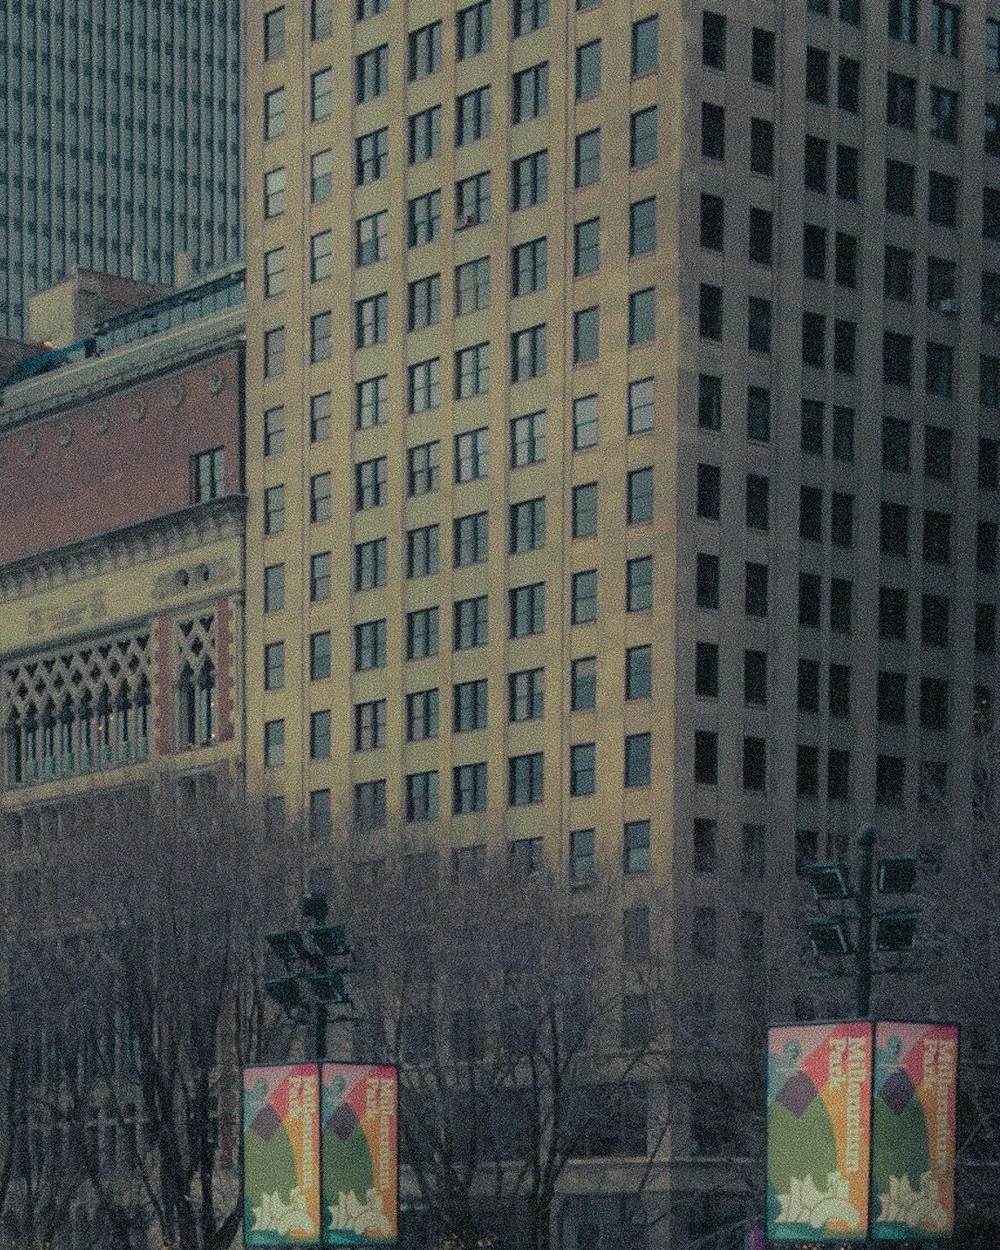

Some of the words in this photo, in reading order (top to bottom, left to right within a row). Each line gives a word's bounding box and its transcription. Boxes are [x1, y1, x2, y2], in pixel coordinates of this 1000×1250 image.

[829, 1037, 845, 1089] Park
[923, 1039, 937, 1089] Park
[289, 1076, 302, 1118] Park
[846, 1036, 866, 1173] Millennium
